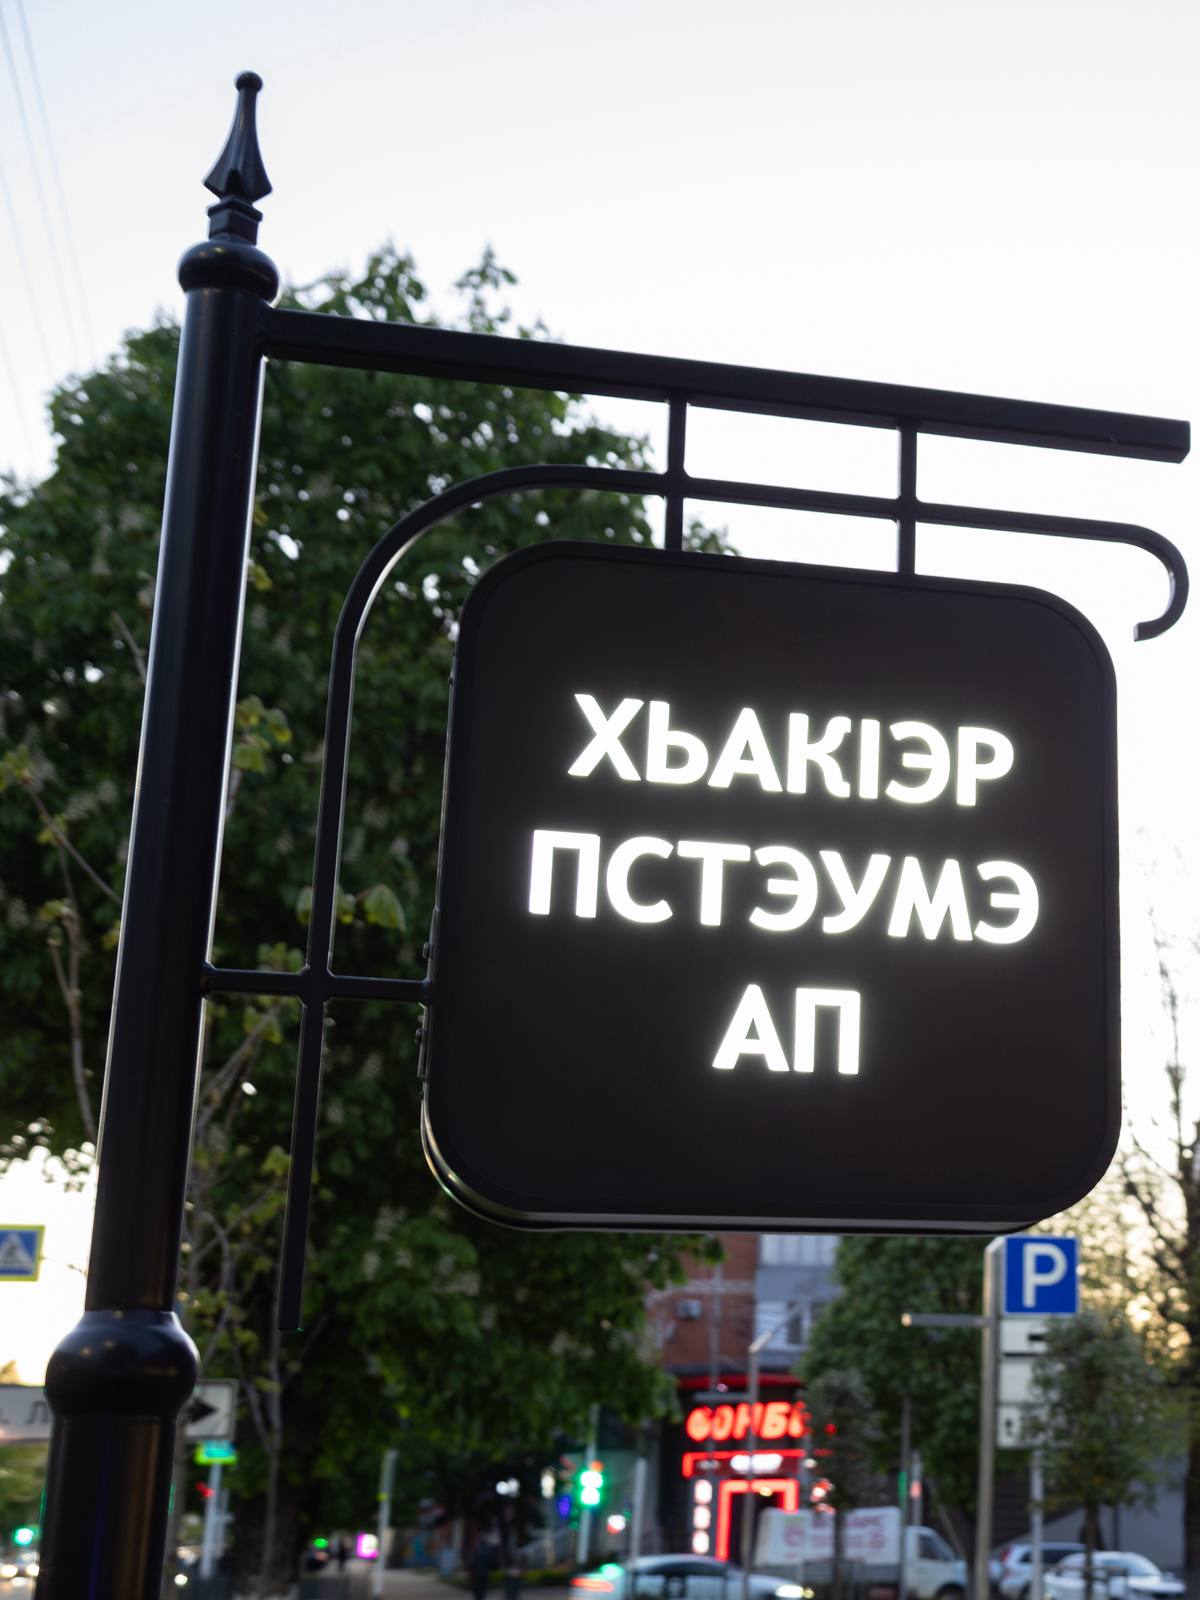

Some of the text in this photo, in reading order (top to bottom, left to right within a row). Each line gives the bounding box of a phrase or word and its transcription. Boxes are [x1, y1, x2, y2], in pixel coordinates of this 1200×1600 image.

[529, 830, 1040, 945] ПСТЭУМЭ
[712, 984, 862, 1076] АП
[1022, 1242, 1067, 1308] P
